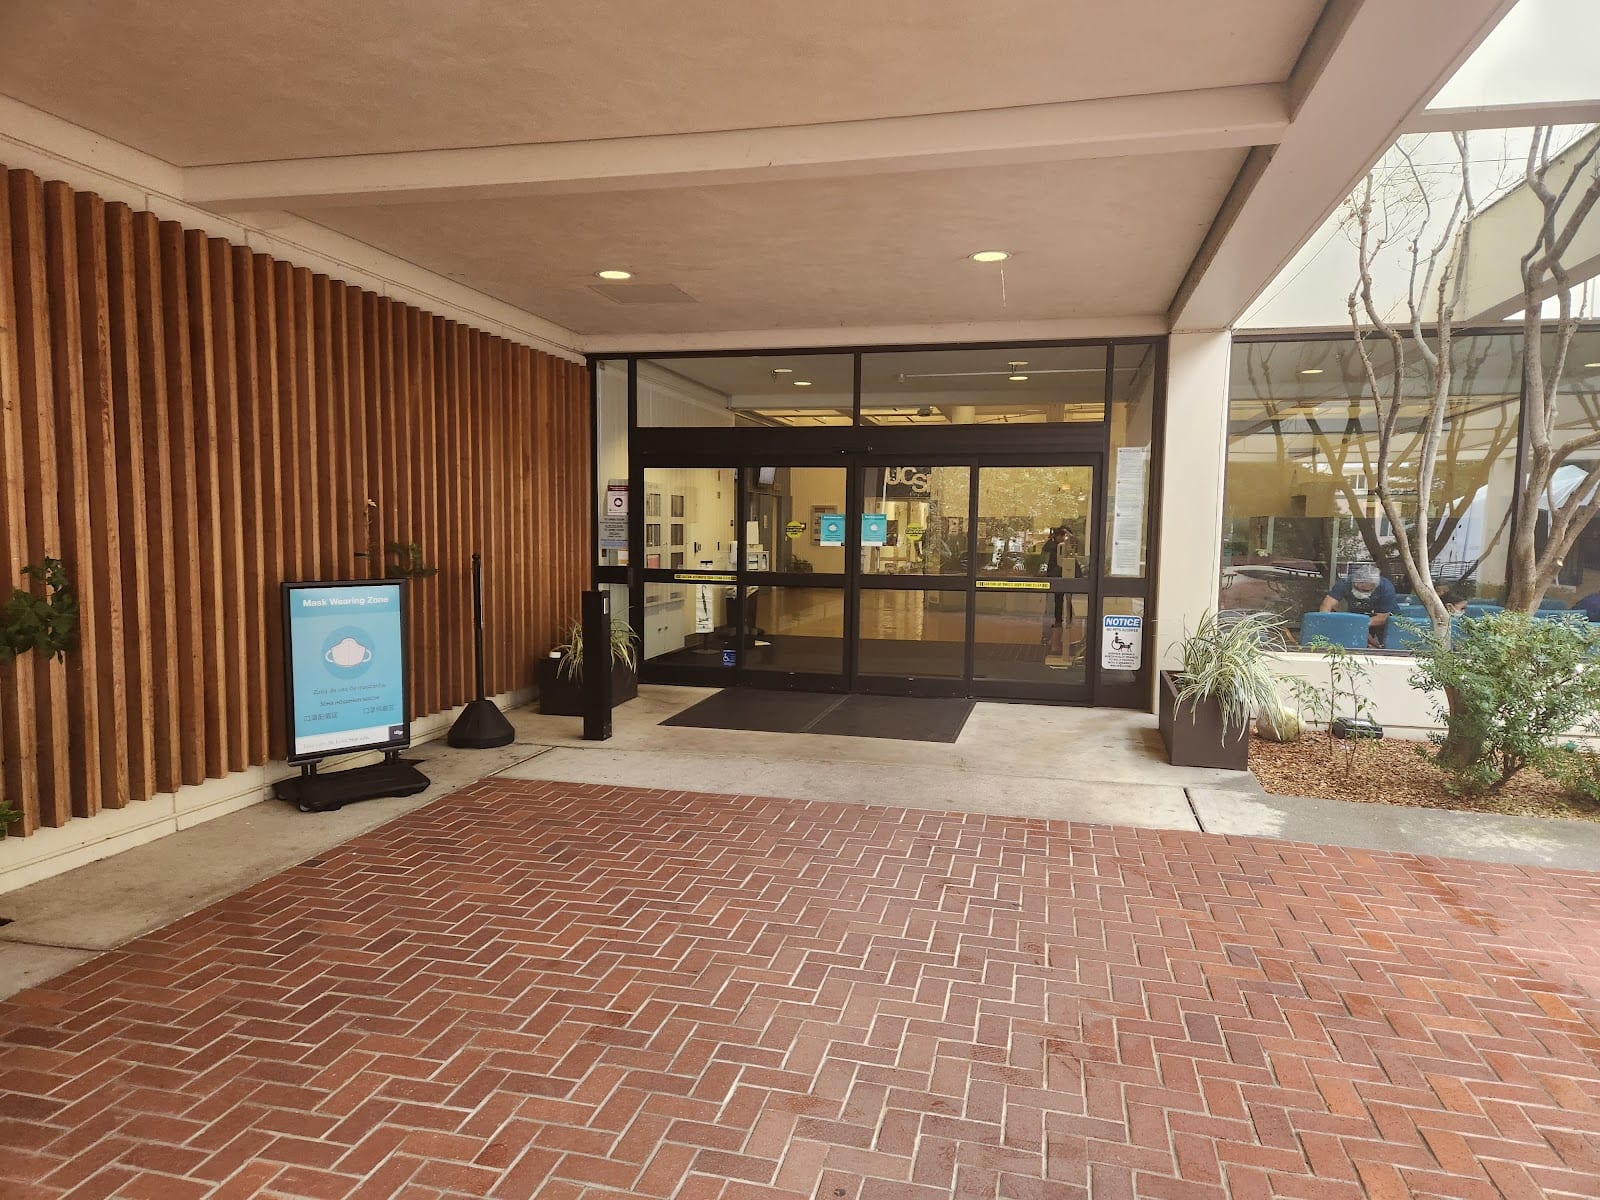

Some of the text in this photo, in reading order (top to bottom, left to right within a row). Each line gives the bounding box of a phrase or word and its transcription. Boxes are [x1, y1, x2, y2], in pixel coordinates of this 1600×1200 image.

[303, 596, 389, 607] Mask Wearing Zone
[1105, 617, 1140, 627] NOTICE
